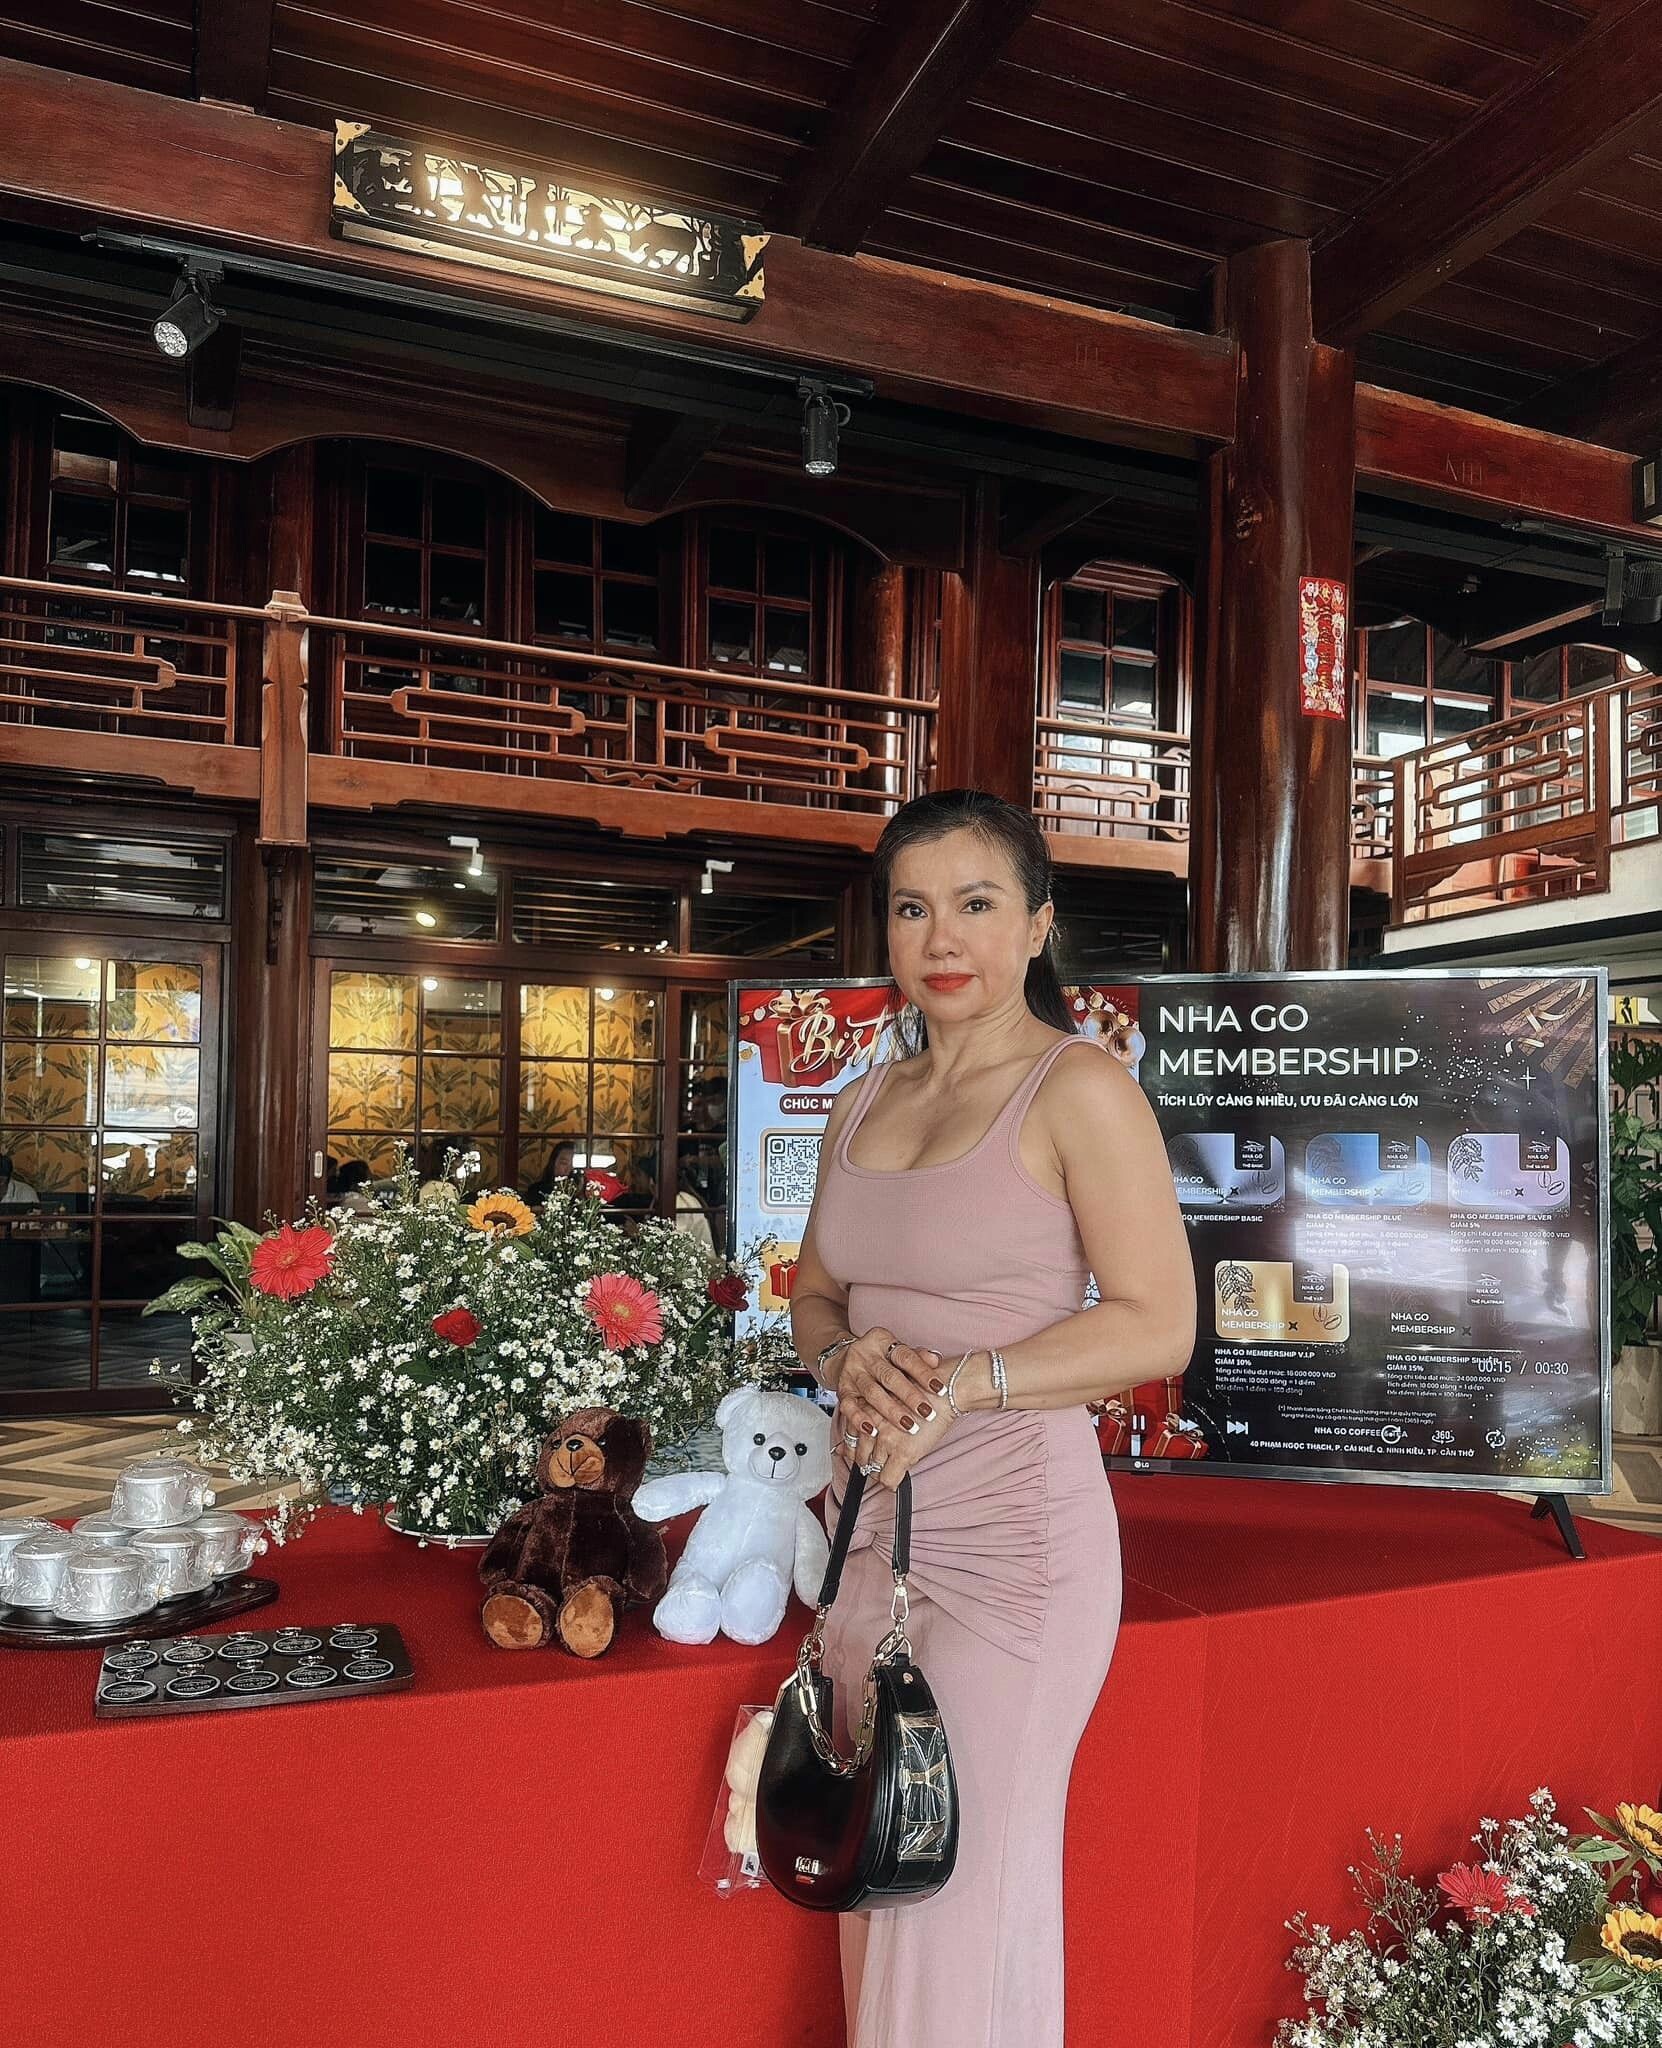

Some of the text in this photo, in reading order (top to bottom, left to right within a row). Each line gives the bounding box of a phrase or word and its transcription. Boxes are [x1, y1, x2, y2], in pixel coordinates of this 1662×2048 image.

[1160, 1004, 1309, 1033] NHA GO
[1159, 1048, 1418, 1076] MEMBERSHIP
[783, 1096, 836, 1109] CHÚC M
[1157, 1093, 1186, 1106] TÍCH
[1216, 1093, 1253, 1106] CÀNG
[1300, 1095, 1320, 1106] ƯU
[1324, 1094, 1346, 1106] ĐÃI
[1349, 1093, 1387, 1106] CÀNG
[1190, 1176, 1204, 1184] GO
[1175, 1187, 1229, 1196] EMBERSHIP
[1244, 1309, 1259, 1317] GO
[1391, 1313, 1429, 1322] NHA GO
[1221, 1321, 1284, 1329] MEMBERSHIP
[1391, 1325, 1455, 1334] MEMBERSHIP
[1246, 1350, 1297, 1358] MEMBERSHIP
[1419, 1355, 1470, 1363] MEMBERSHIP
[1478, 1360, 1568, 1375] 00:15 / 00:30
[1348, 1428, 1380, 1436] COFFEE
[1260, 1441, 1281, 1450] PHẠM
[1283, 1442, 1304, 1450] NGỌC
